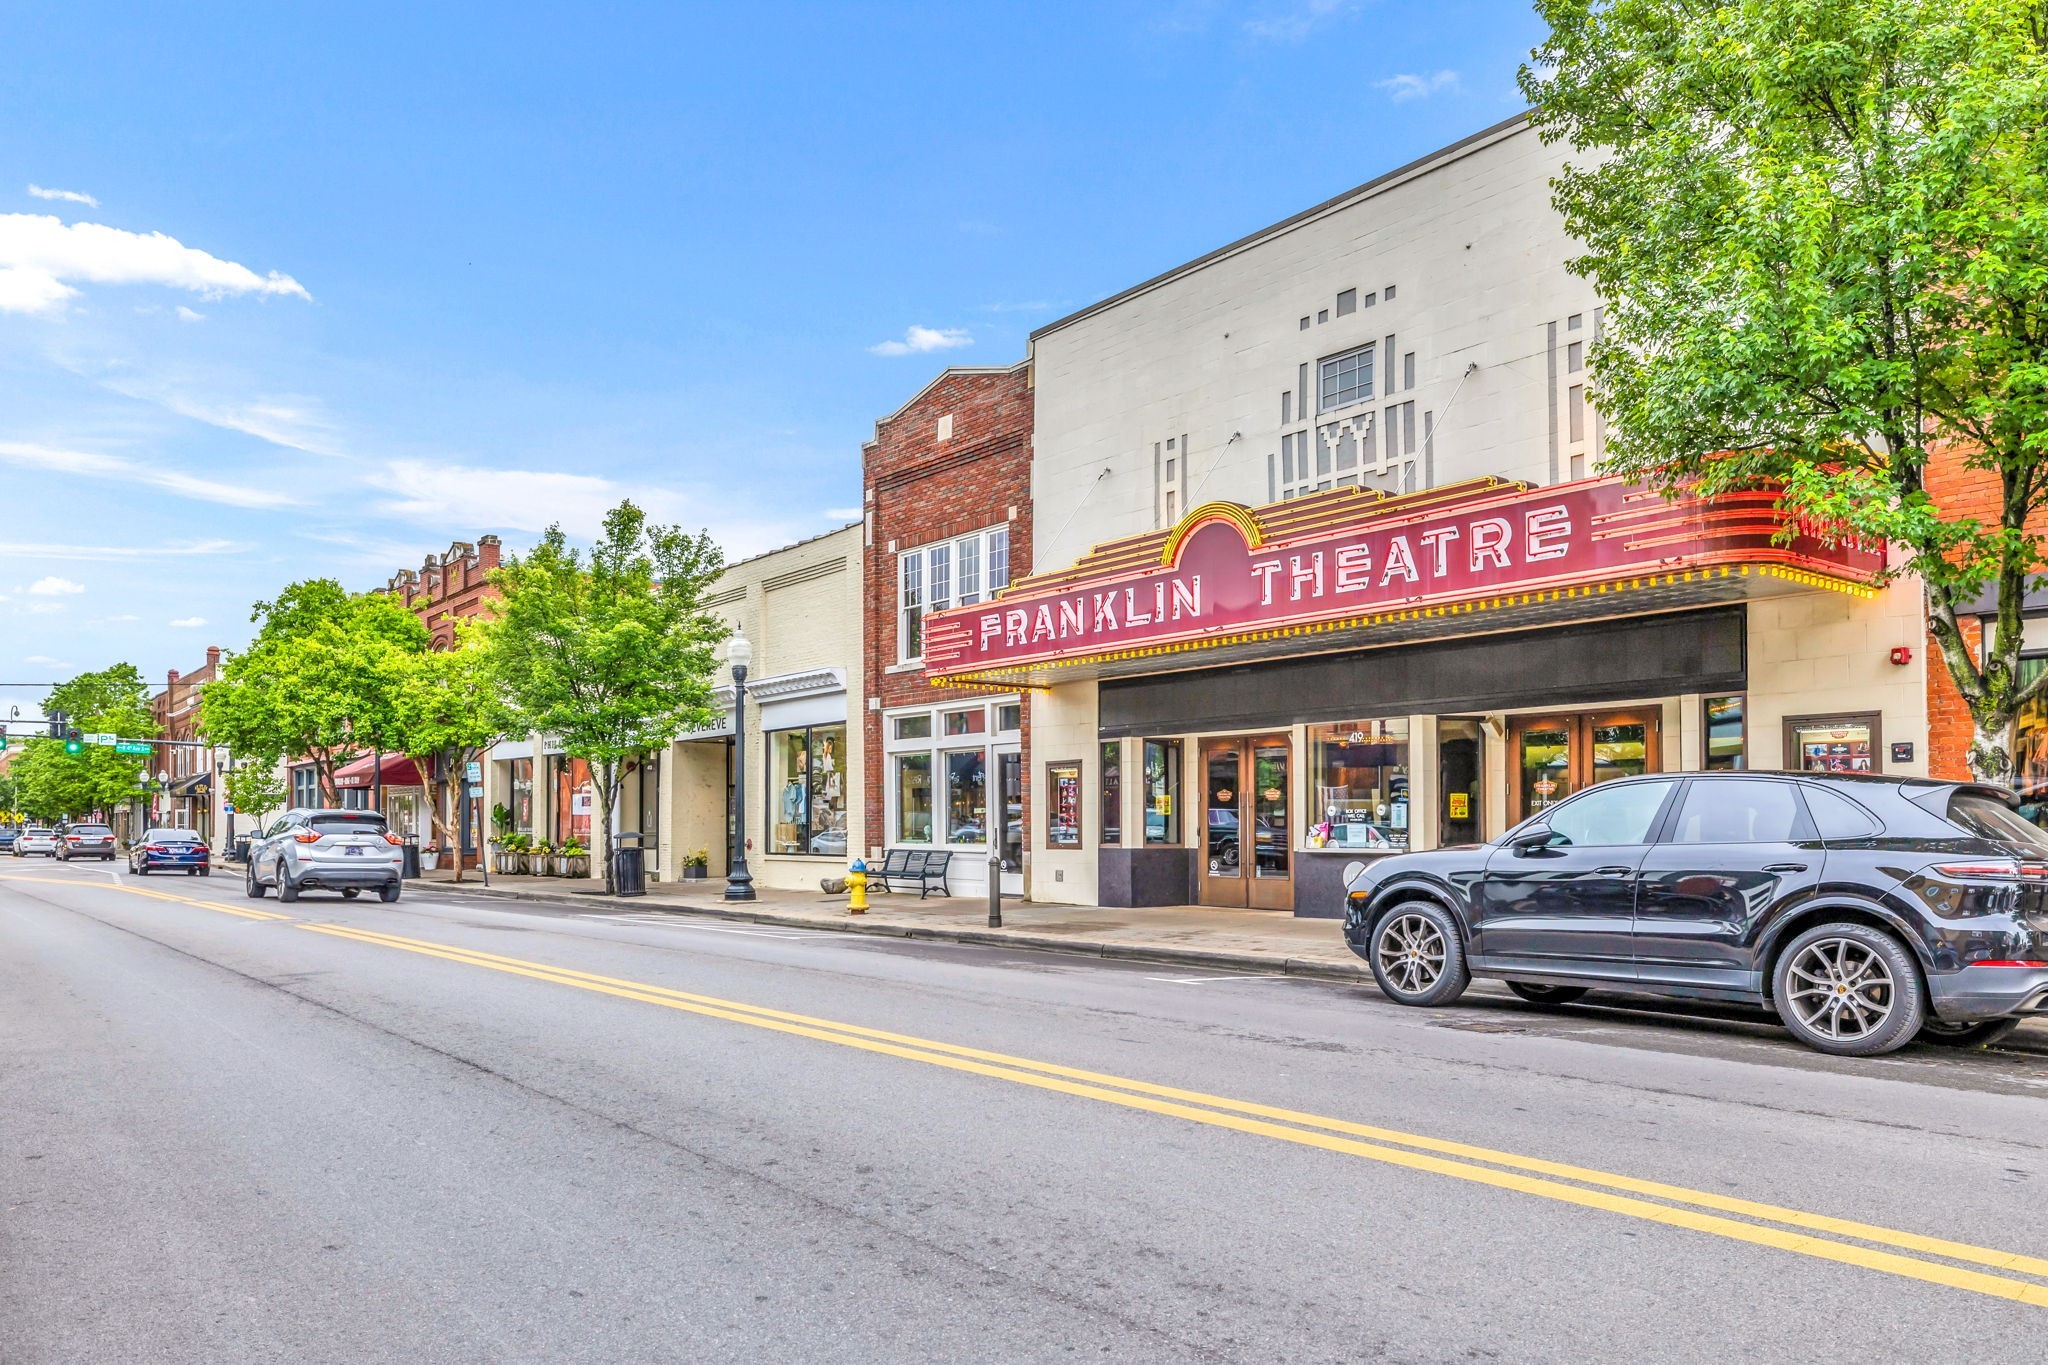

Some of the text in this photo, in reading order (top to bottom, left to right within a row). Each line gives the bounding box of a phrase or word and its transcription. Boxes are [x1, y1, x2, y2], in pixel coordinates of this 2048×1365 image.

[980, 504, 1571, 651] FRANKLIN THEATRE
[1348, 732, 1363, 742] 419
